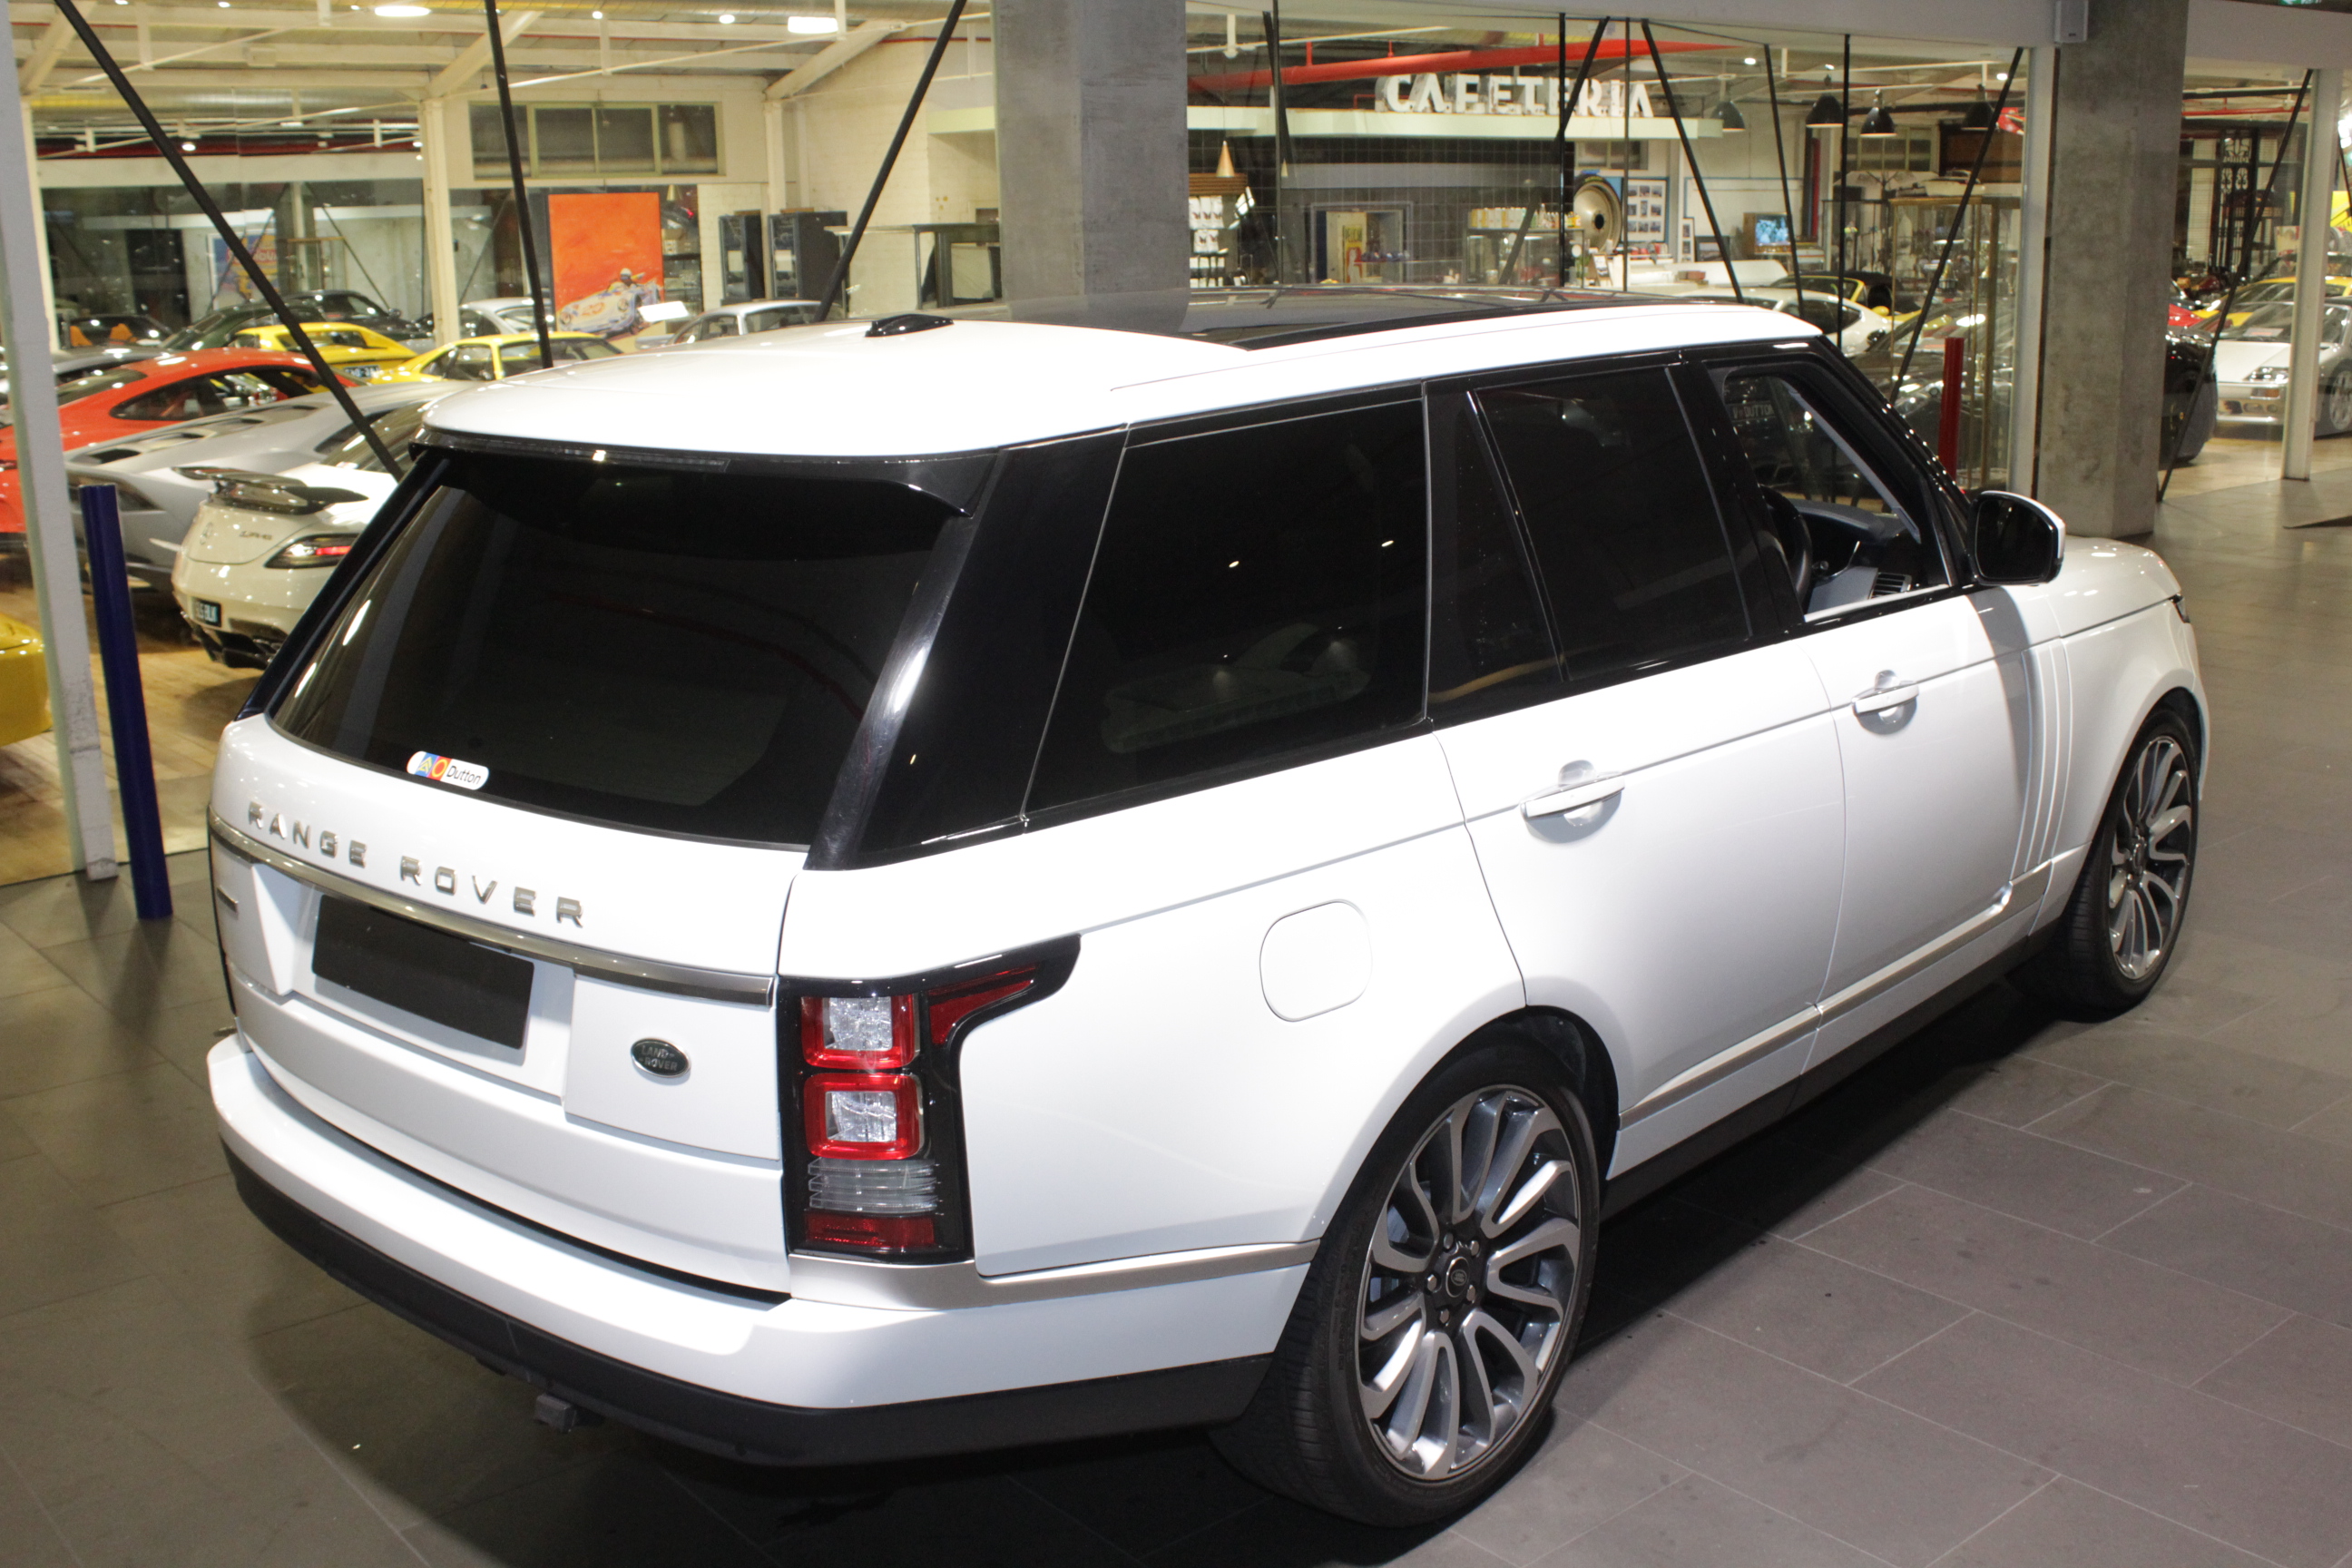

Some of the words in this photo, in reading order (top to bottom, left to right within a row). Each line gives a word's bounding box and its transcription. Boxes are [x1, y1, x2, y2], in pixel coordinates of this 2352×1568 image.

[1379, 73, 1653, 117] CAFETERIA
[446, 765, 481, 785] Dutton
[249, 801, 367, 867] RANGE
[401, 856, 583, 927] ROVER
